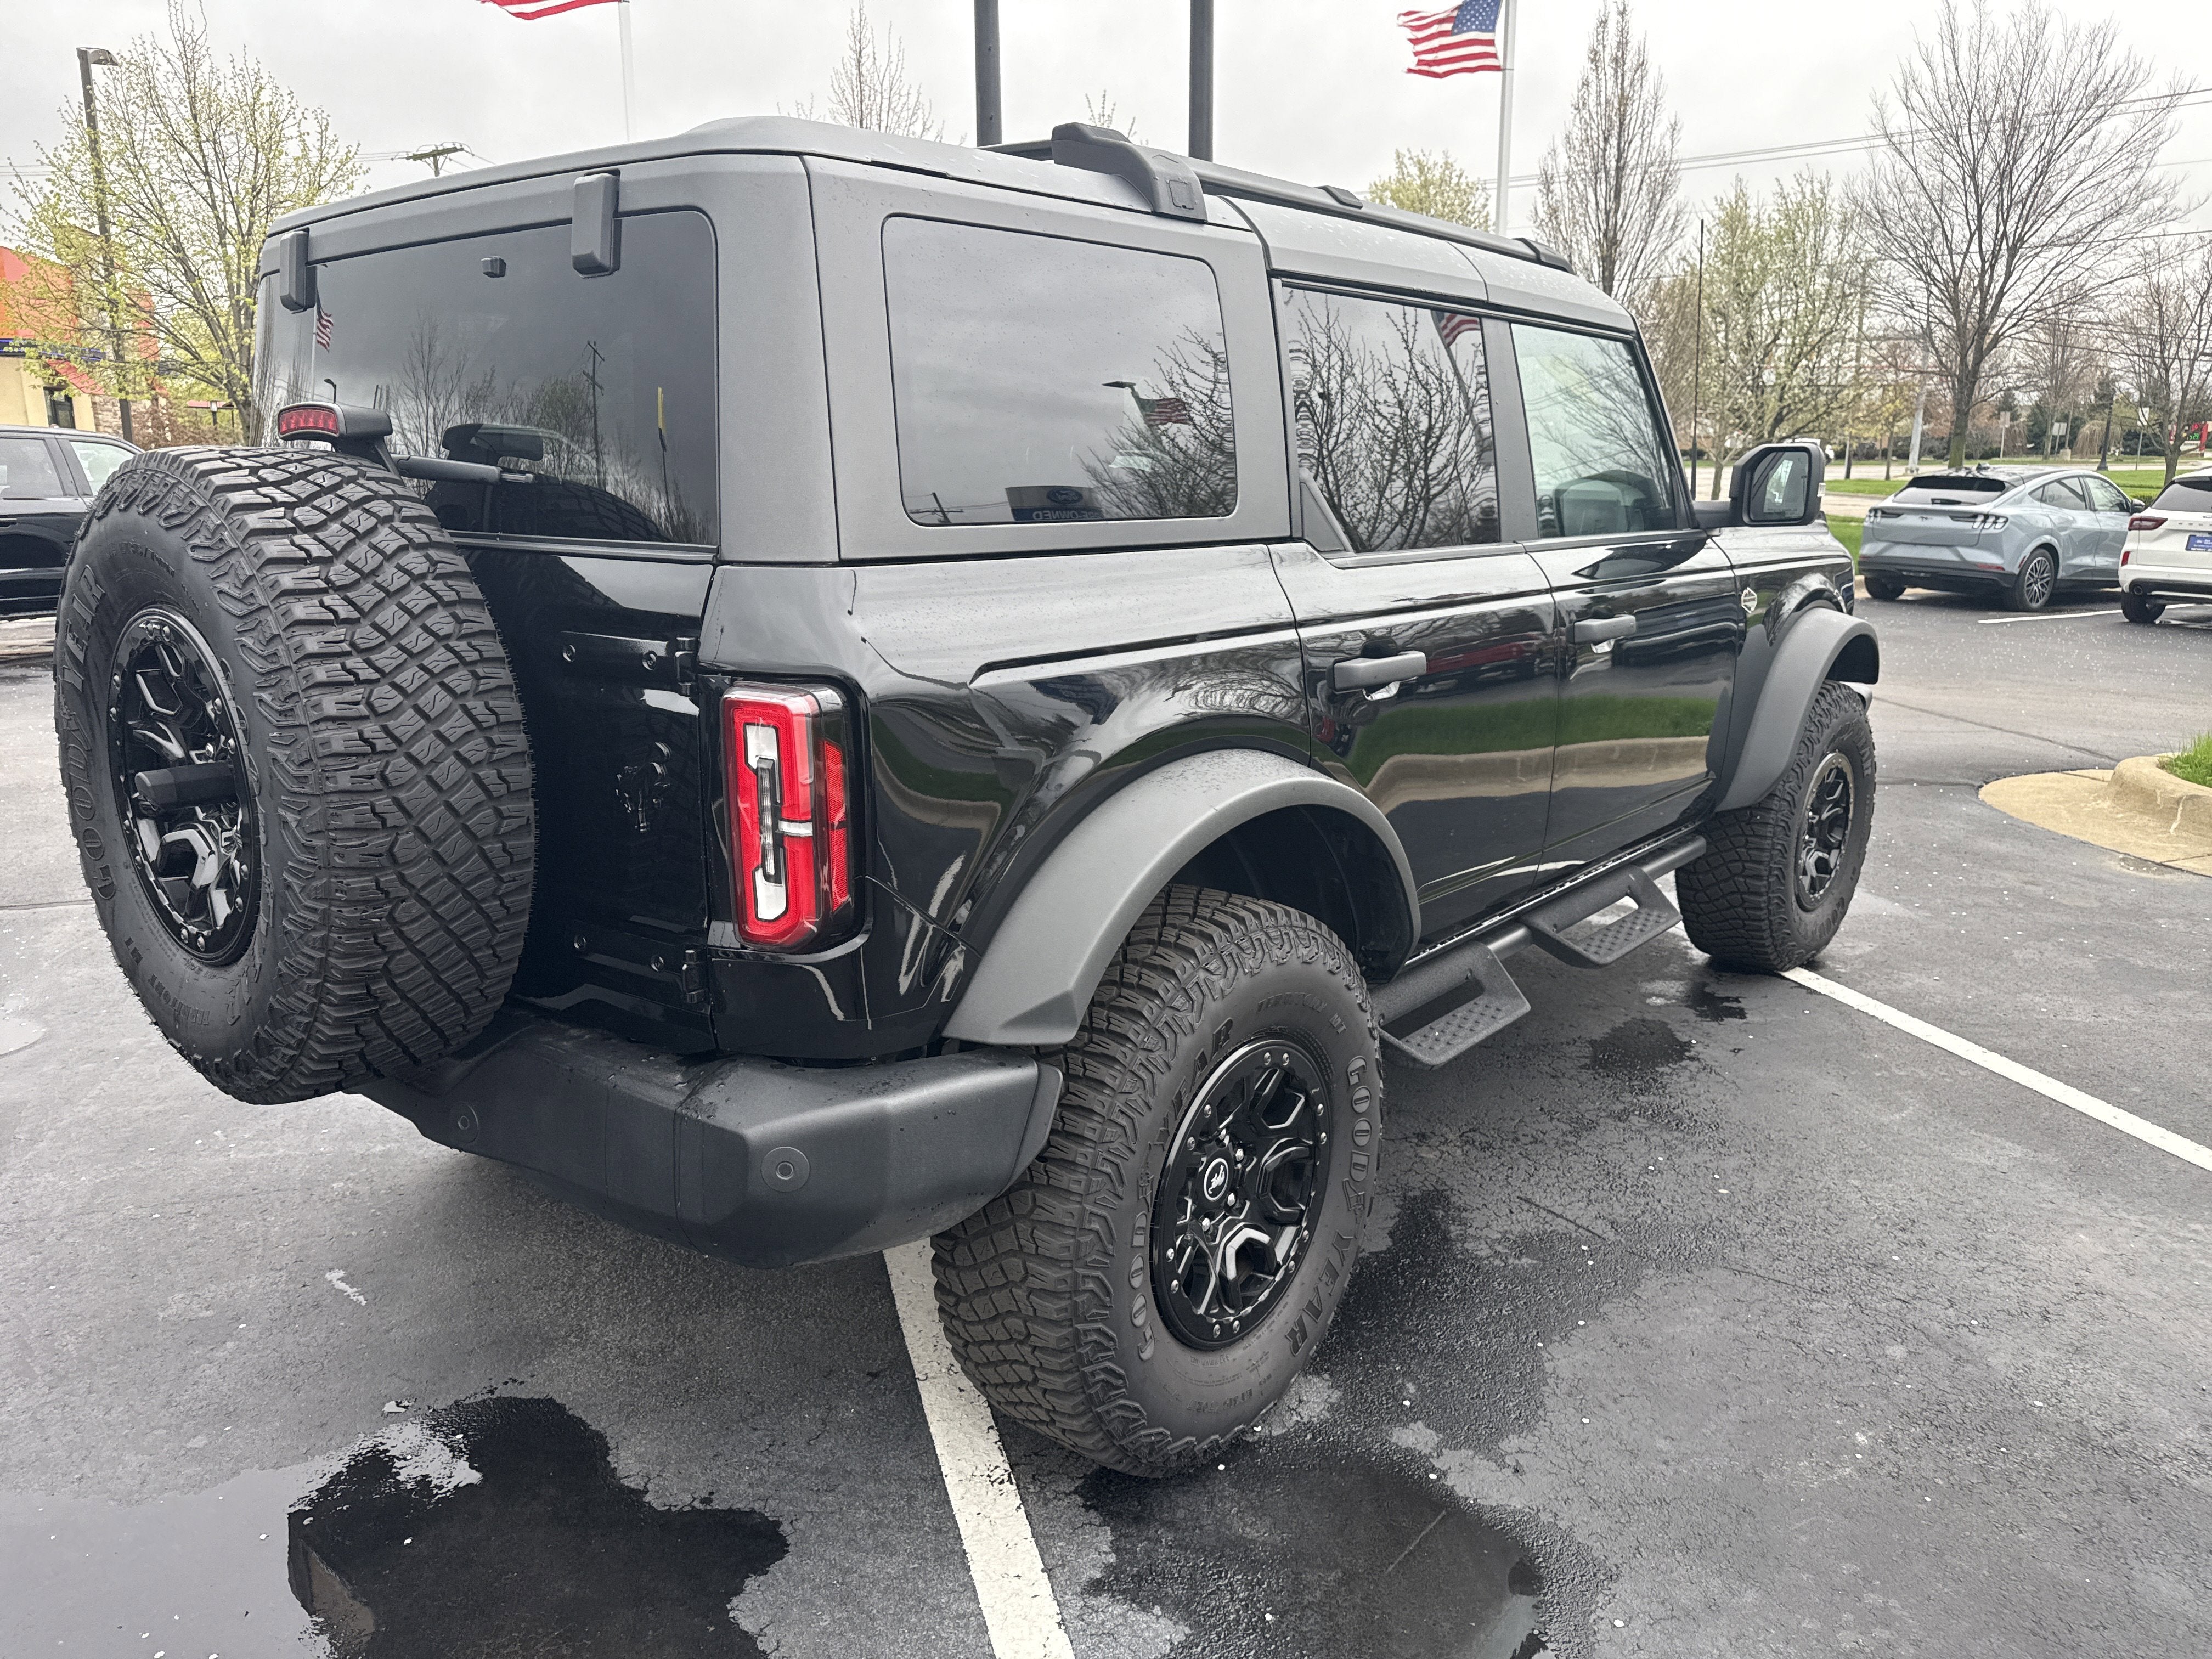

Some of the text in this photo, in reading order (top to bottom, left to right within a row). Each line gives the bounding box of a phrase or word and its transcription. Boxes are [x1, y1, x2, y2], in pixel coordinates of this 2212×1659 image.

[58, 564, 116, 899] GOODYEAR
[1256, 991, 1347, 1035] TERRITORY MT
[1285, 1055, 1372, 1357] GOODYEAR
